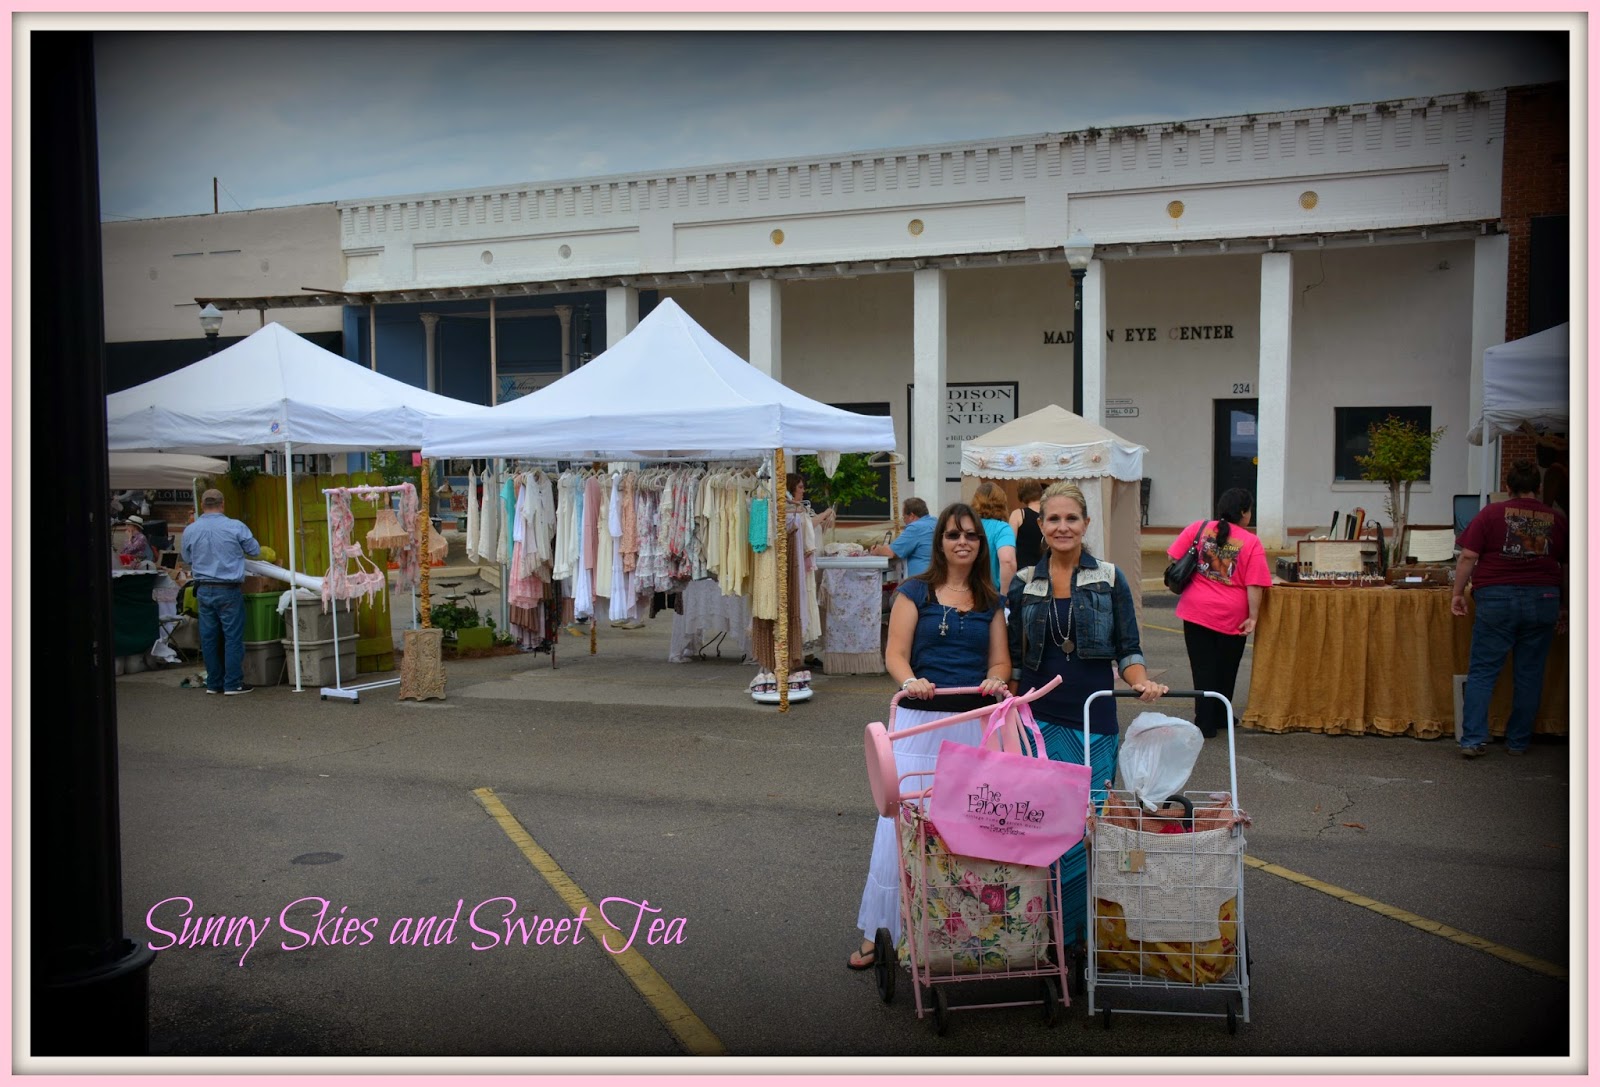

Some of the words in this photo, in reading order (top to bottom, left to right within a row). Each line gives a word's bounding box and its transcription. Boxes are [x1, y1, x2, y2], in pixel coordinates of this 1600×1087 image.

[1043, 328, 1115, 345] MADN
[1125, 327, 1157, 342] EYE
[1168, 325, 1235, 341] CENTER
[946, 388, 1013, 400] DISON
[1232, 383, 1250, 394] 234
[946, 401, 984, 413] EYE
[946, 413, 1006, 425] NTER
[976, 783, 1002, 803] The
[967, 793, 1014, 820] Fancy
[1014, 800, 1045, 824] Flea
